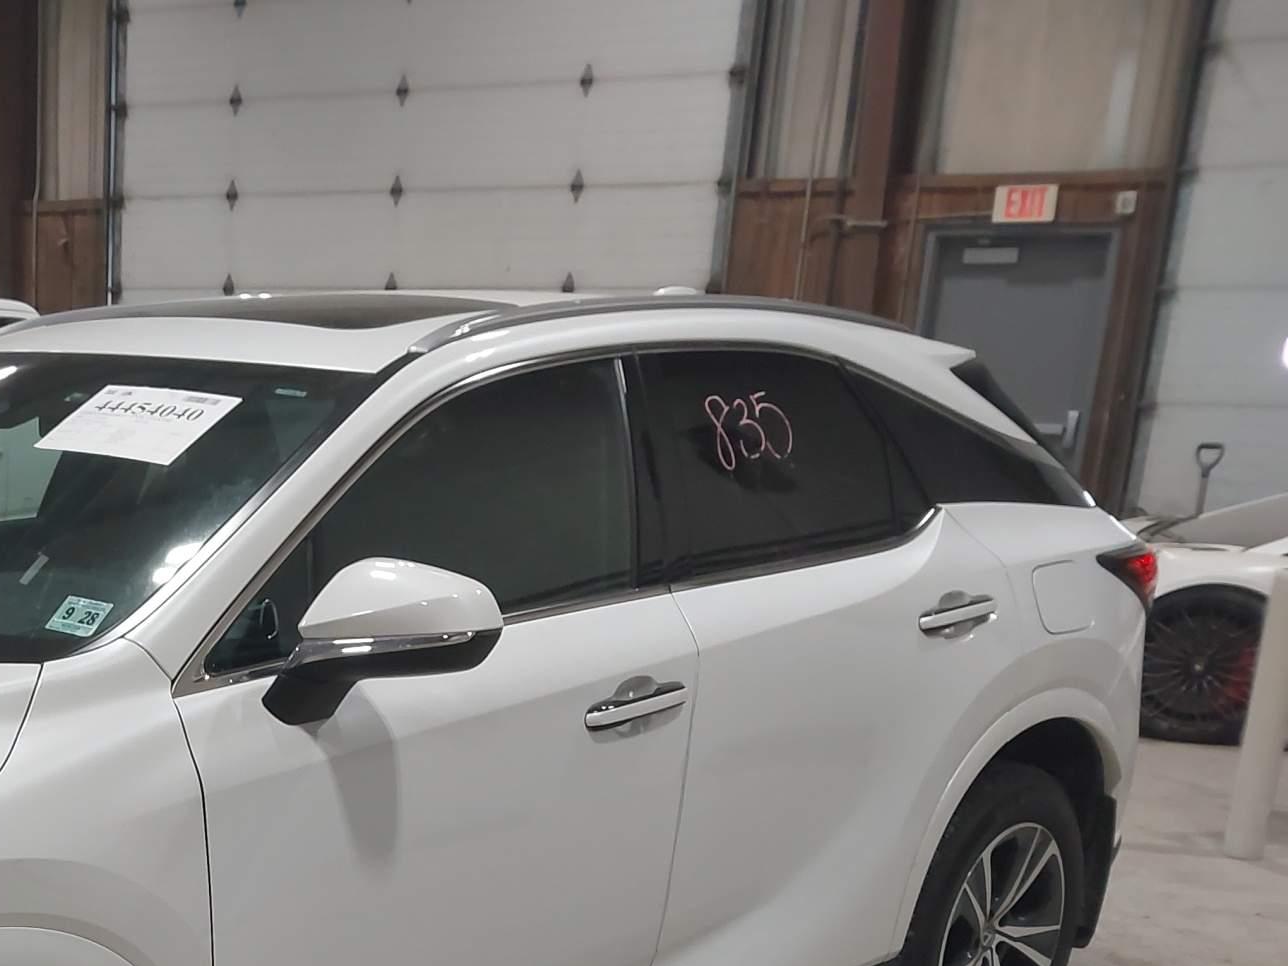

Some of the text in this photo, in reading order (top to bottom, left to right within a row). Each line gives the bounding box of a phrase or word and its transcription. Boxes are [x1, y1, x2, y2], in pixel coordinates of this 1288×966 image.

[1004, 186, 1048, 219] EXIT
[95, 399, 205, 422] 44454040
[704, 391, 793, 471] 835
[62, 606, 76, 620] 9
[78, 610, 100, 626] 28
